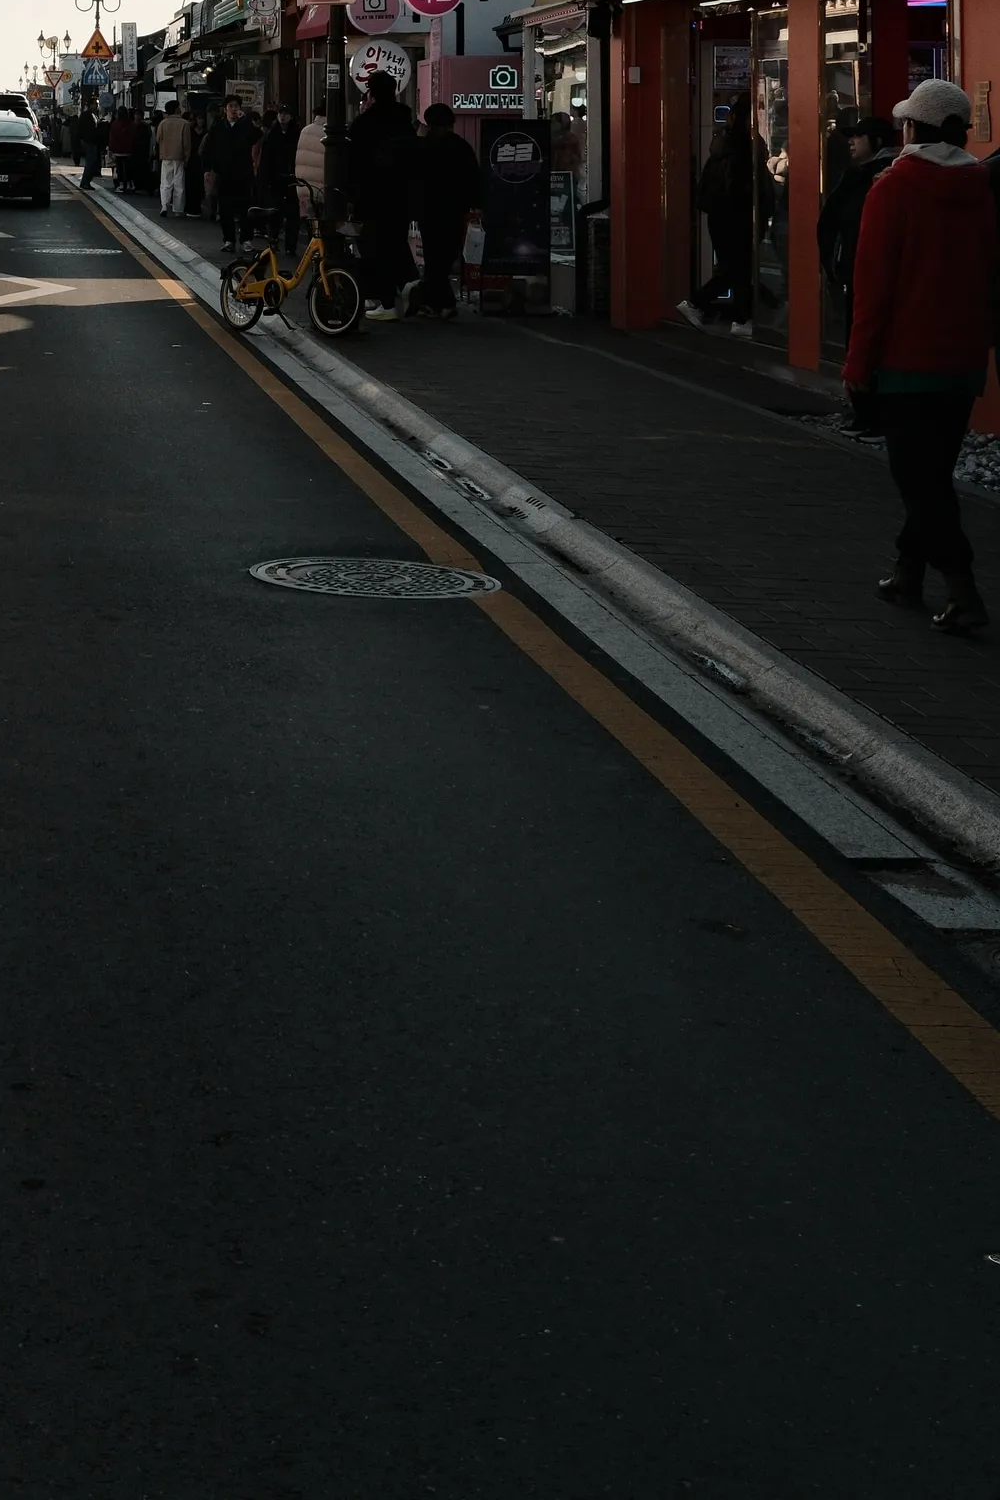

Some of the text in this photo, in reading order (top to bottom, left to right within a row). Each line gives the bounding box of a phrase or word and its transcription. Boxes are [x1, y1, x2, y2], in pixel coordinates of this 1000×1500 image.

[366, 46, 405, 66] 이가네
[453, 94, 524, 108] PLAY IN THE
